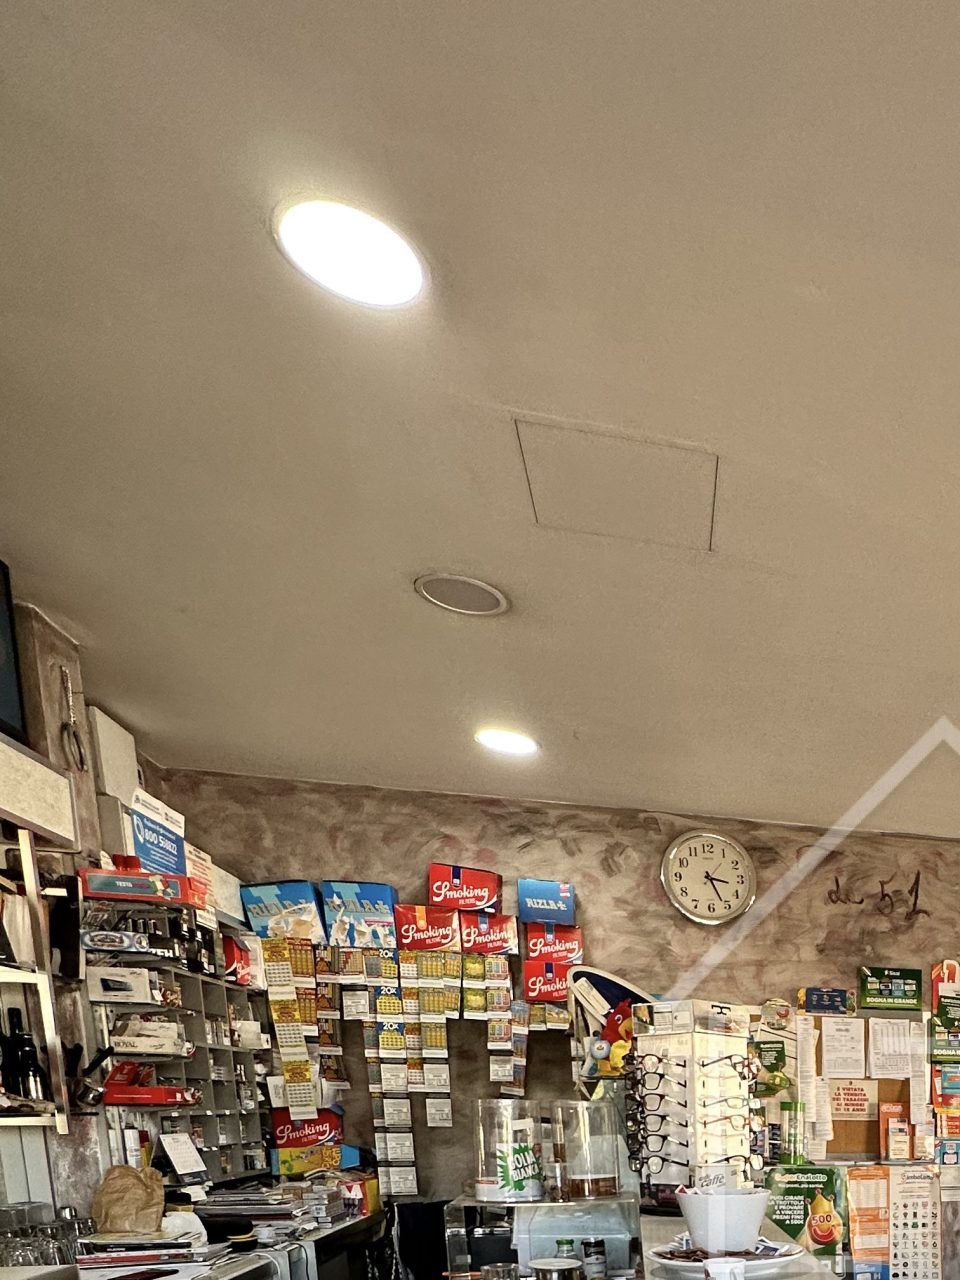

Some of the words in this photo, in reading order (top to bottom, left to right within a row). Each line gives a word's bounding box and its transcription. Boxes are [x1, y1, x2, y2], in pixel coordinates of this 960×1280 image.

[689, 846, 697, 857] 11
[702, 844, 714, 854] 12
[721, 848, 725, 858] 1
[679, 857, 689, 868] 10
[731, 860, 739, 870] 2
[674, 872, 682, 882] 9
[737, 875, 744, 884] 3
[432, 881, 489, 906] Smoking
[680, 887, 688, 897] 8
[732, 889, 739, 899] 4
[247, 899, 306, 918] RIZLA
[692, 899, 699, 909] 7
[707, 903, 715, 913] 6
[724, 900, 731, 910] 5
[401, 925, 453, 944] Smoking
[462, 927, 514, 948] Smoking
[529, 938, 579, 958] Smoking
[528, 977, 569, 997] Smoki
[276, 1122, 330, 1145] Smoking
[812, 1214, 832, 1225] 500
